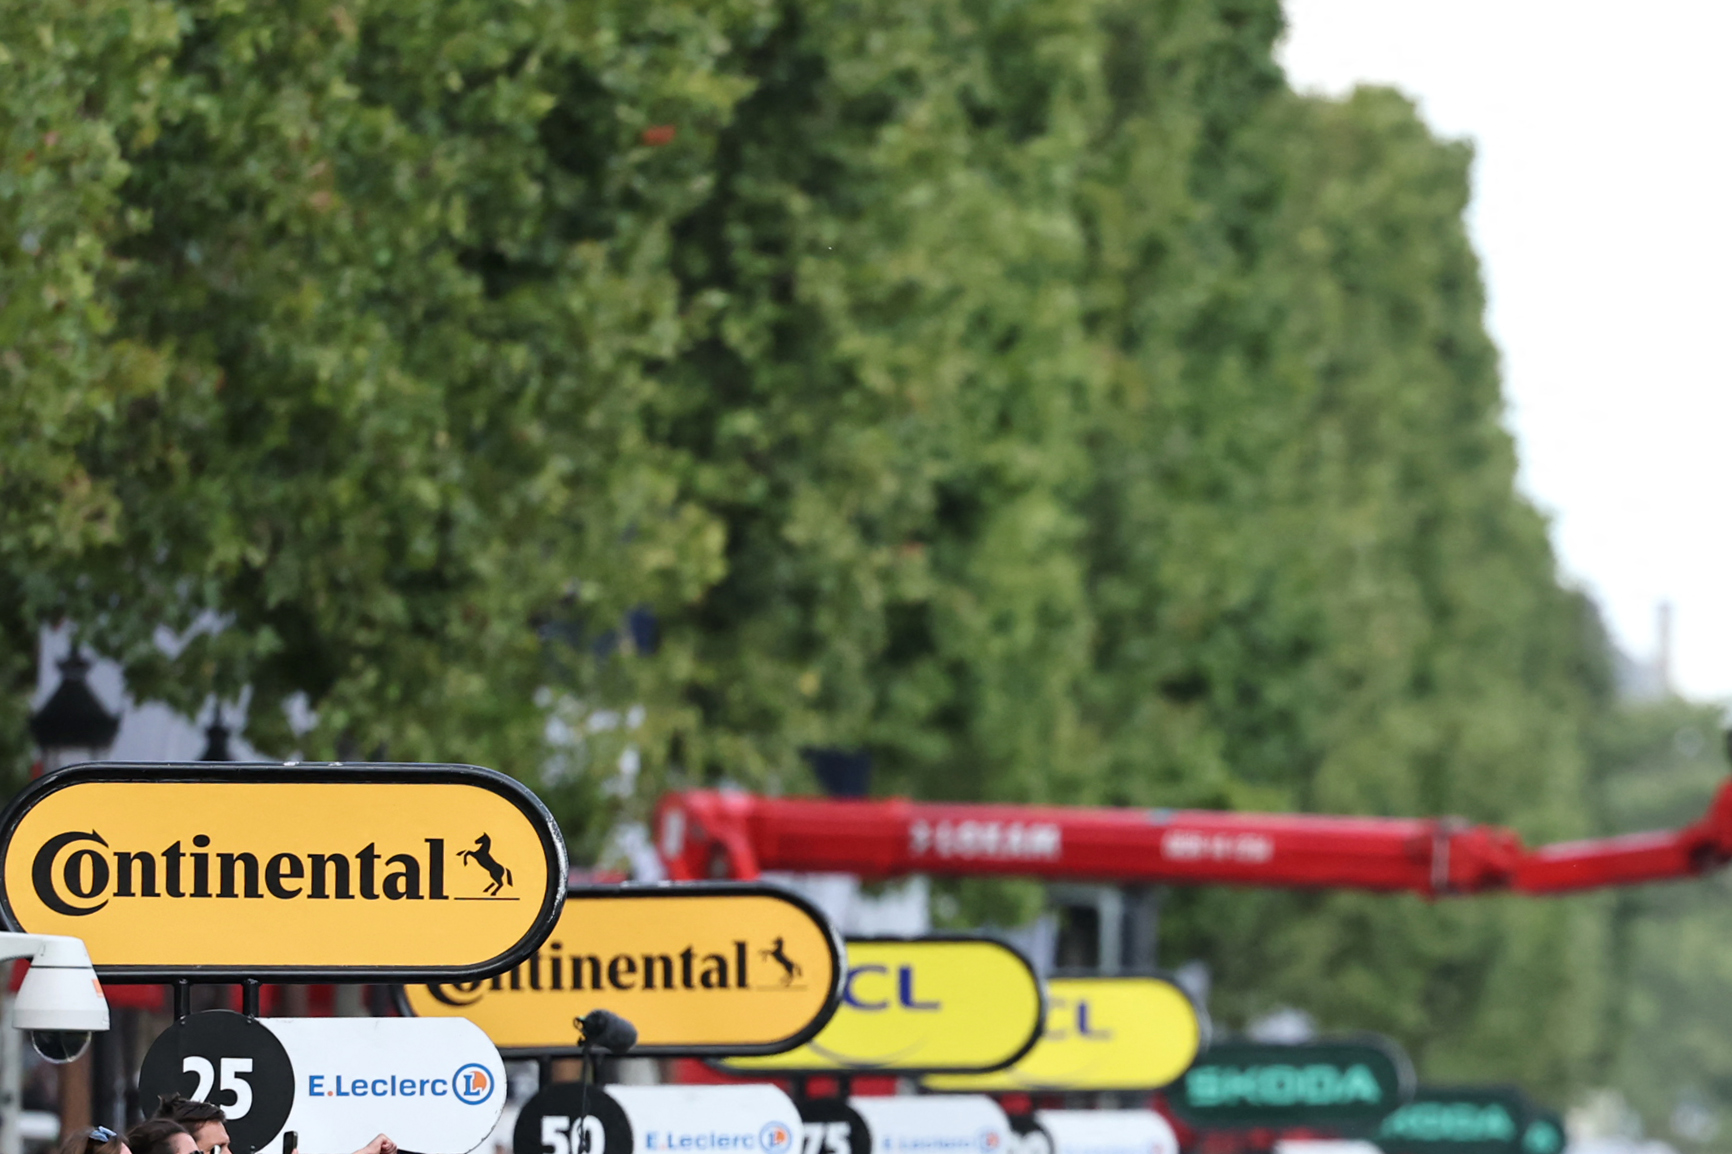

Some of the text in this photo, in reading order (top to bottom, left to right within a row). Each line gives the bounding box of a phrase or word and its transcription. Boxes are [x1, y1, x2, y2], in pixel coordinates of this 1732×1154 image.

[32, 830, 449, 916] Continental
[843, 966, 940, 1010] CL
[182, 1056, 253, 1120] 25
[309, 1074, 448, 1098] E.Leclerc
[645, 1131, 755, 1150] E.Leclerc
